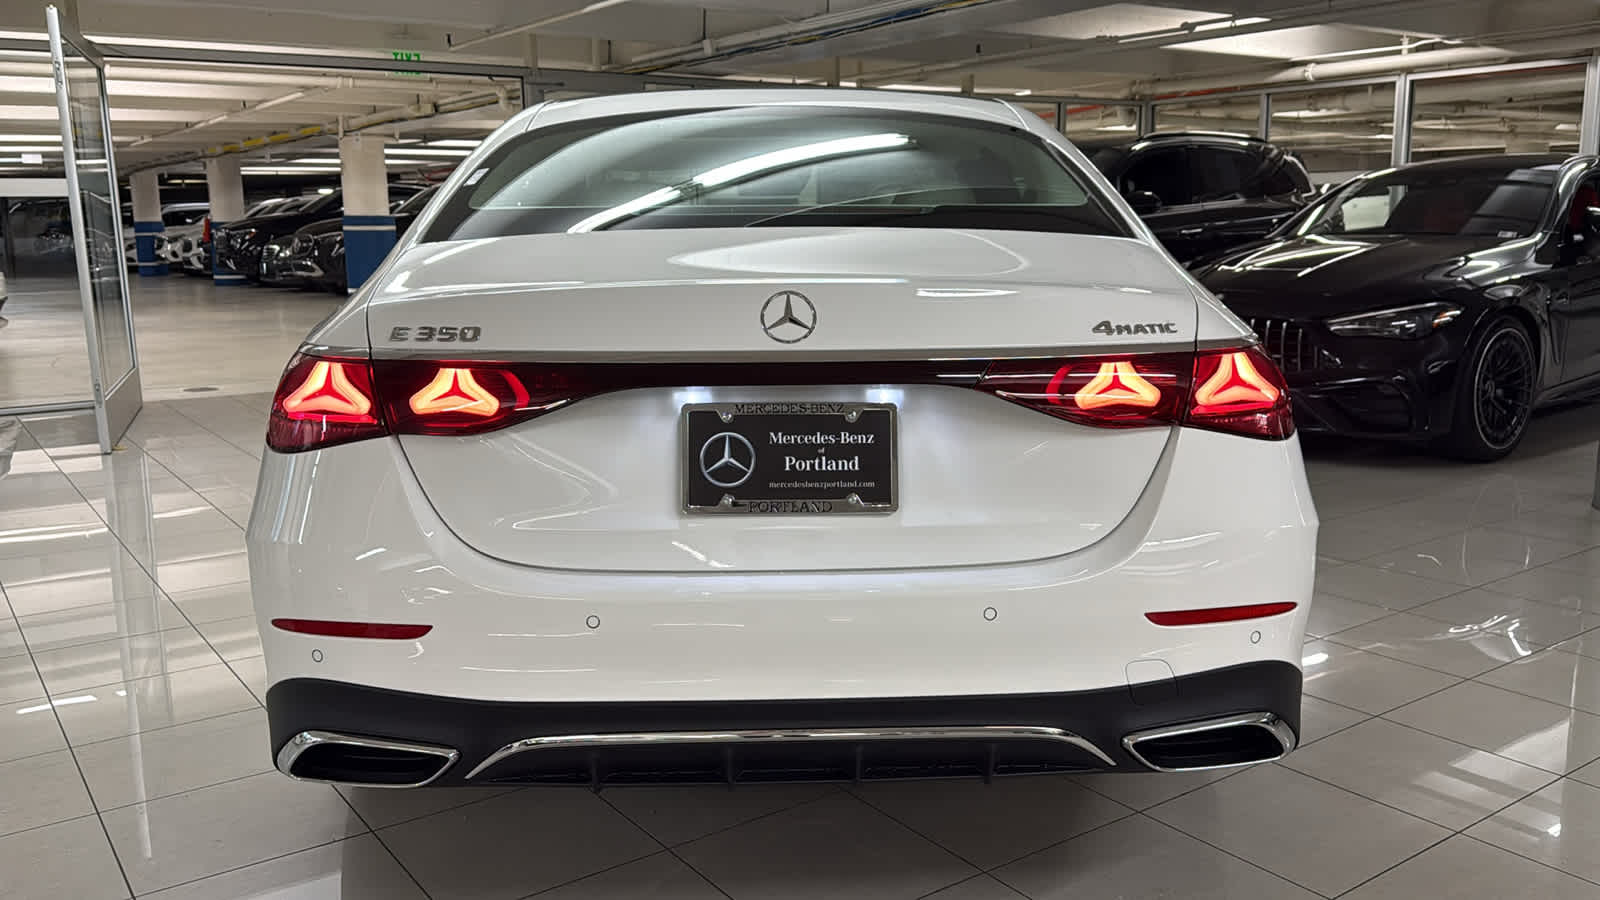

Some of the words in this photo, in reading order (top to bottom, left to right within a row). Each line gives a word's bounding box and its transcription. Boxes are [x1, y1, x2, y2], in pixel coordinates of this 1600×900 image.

[389, 326, 412, 342] E
[414, 326, 481, 342] 350
[1092, 320, 1178, 336] 4MATIC
[734, 403, 845, 414] MERCEDES-BENZ
[769, 431, 875, 445] Mercedes-Benz
[784, 455, 860, 471] Portland
[769, 480, 875, 489] mercedesbenzportland.com
[749, 501, 833, 513] PORTLAND
